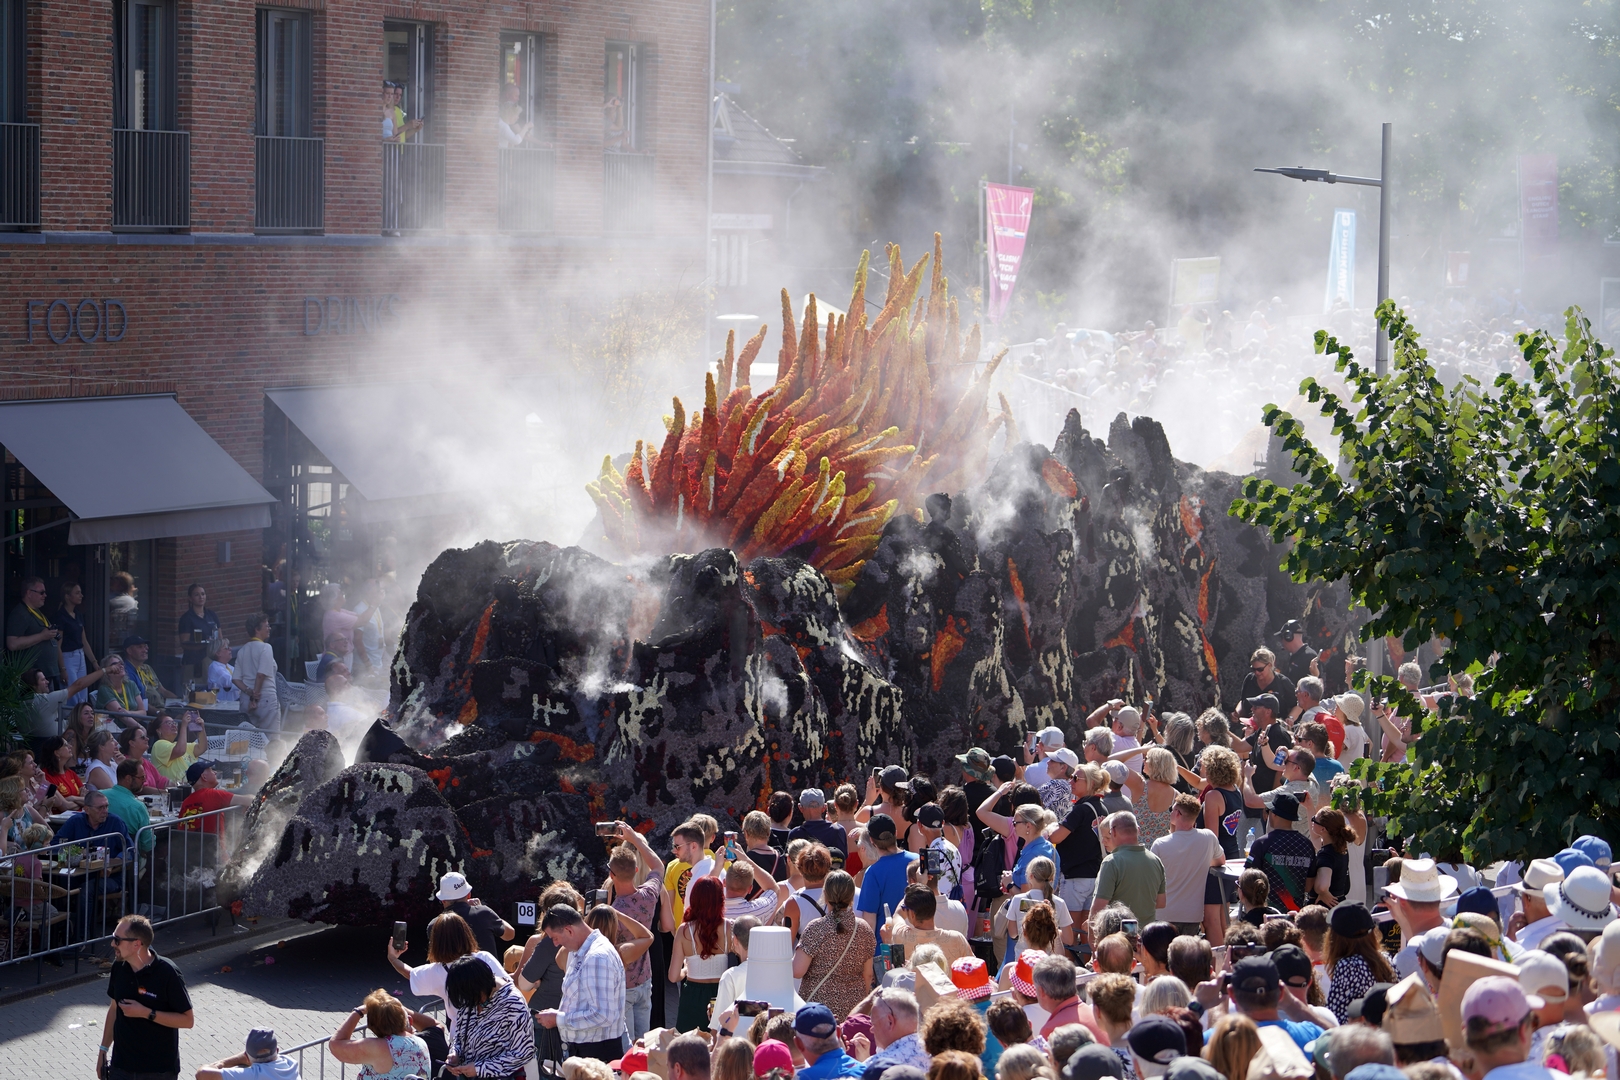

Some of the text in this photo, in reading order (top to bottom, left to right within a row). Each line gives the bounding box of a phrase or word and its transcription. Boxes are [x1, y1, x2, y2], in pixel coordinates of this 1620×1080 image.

[28, 300, 128, 344] FOOD
[304, 294, 402, 335] DRINKS
[519, 906, 533, 917] 08
